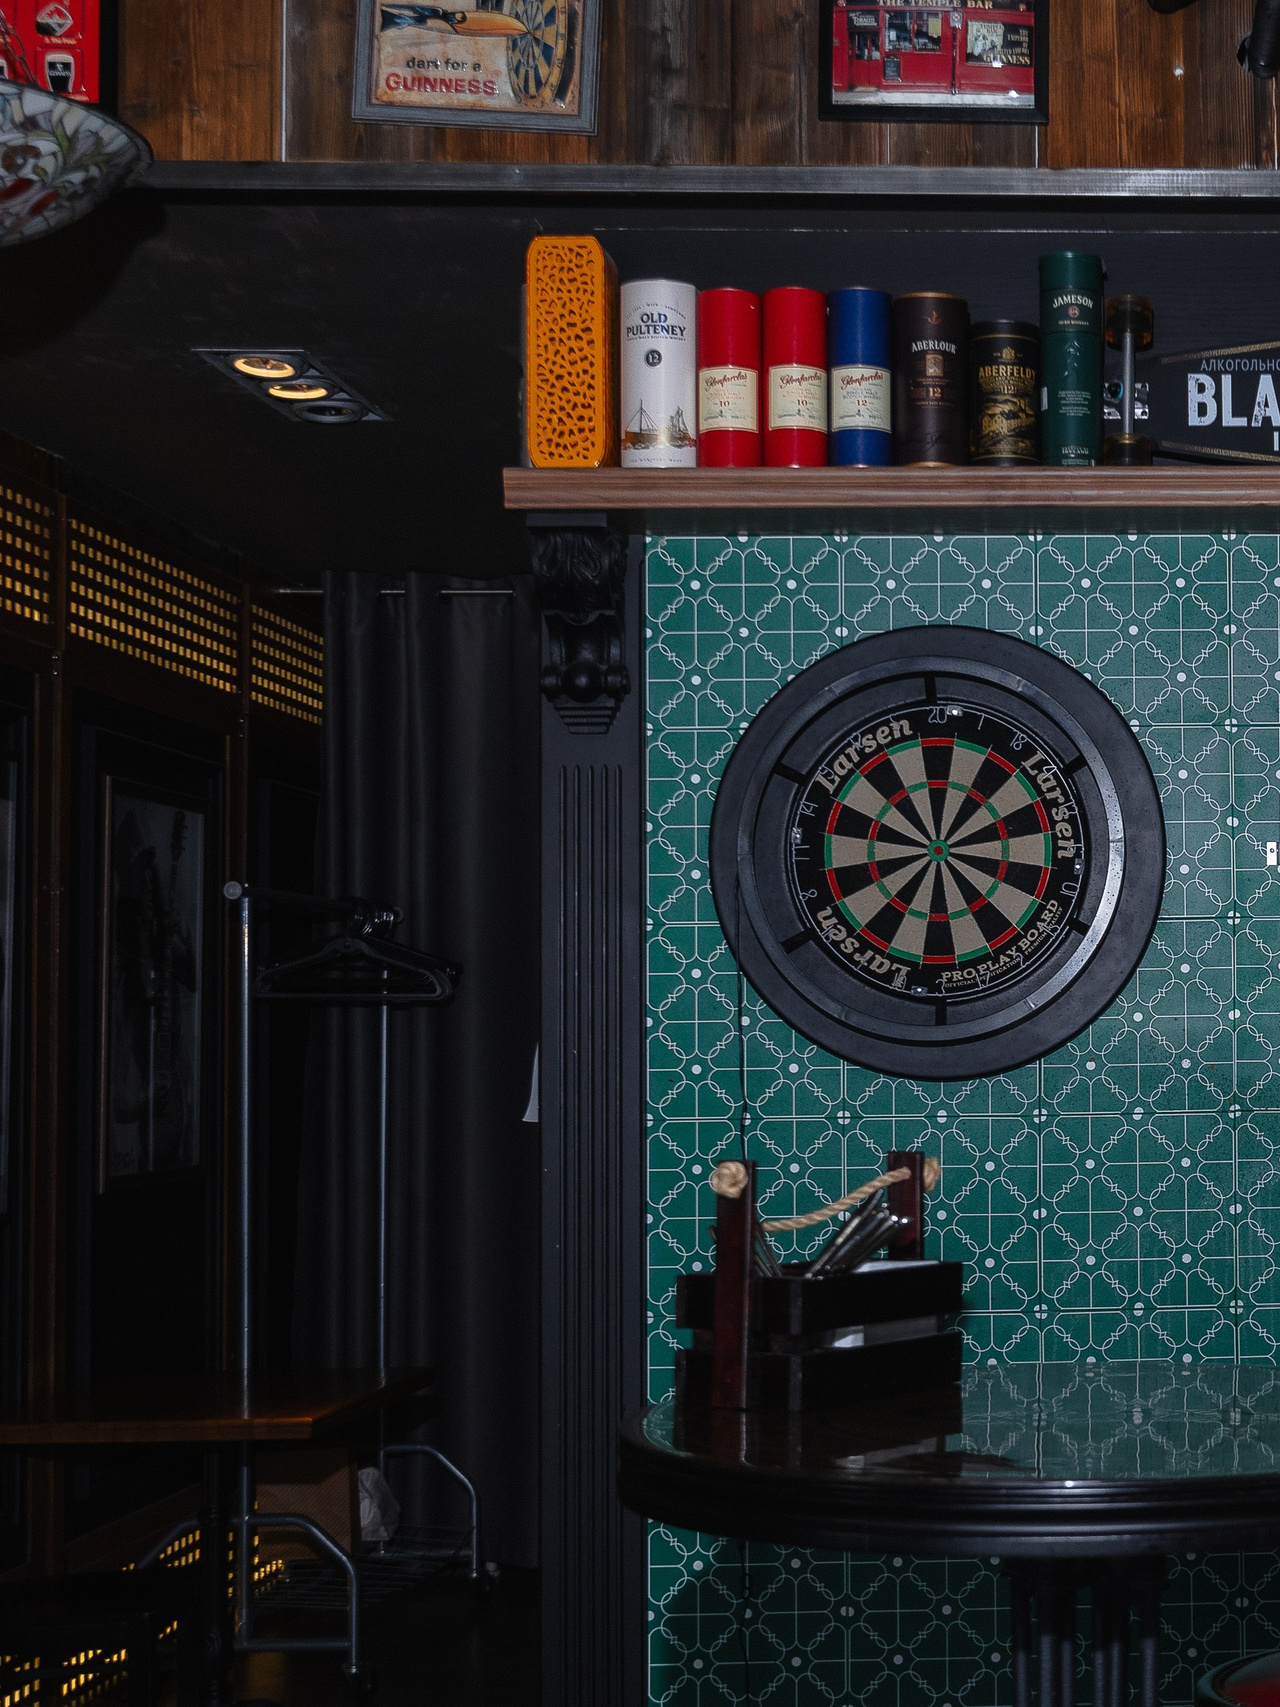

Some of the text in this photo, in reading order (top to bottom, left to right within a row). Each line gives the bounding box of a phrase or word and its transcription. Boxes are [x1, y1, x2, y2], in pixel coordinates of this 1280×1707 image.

[967, 0, 993, 9] BAR
[406, 57, 482, 73] dart for a
[385, 73, 499, 95] GUINNESS
[1052, 294, 1094, 309] JAMESON
[640, 312, 668, 324] OLD
[626, 324, 686, 338] PULTENEY
[911, 340, 956, 354] ABERLOUR
[649, 353, 659, 363] 12
[978, 365, 1036, 380] ABERFELDY
[928, 387, 942, 397] 12
[1004, 385, 1015, 395] 12
[928, 707, 948, 724] 20
[1010, 732, 1028, 750] 18
[815, 719, 913, 794] Larsen
[800, 801, 818, 816] 14
[1021, 750, 1075, 859] Larsen
[800, 888, 818, 901] 8
[1060, 882, 1080, 897] 10
[816, 906, 912, 988] Larsen
[941, 900, 1059, 982] PRO PLAY BOARD
[1024, 932, 1048, 955] PREMIUM
